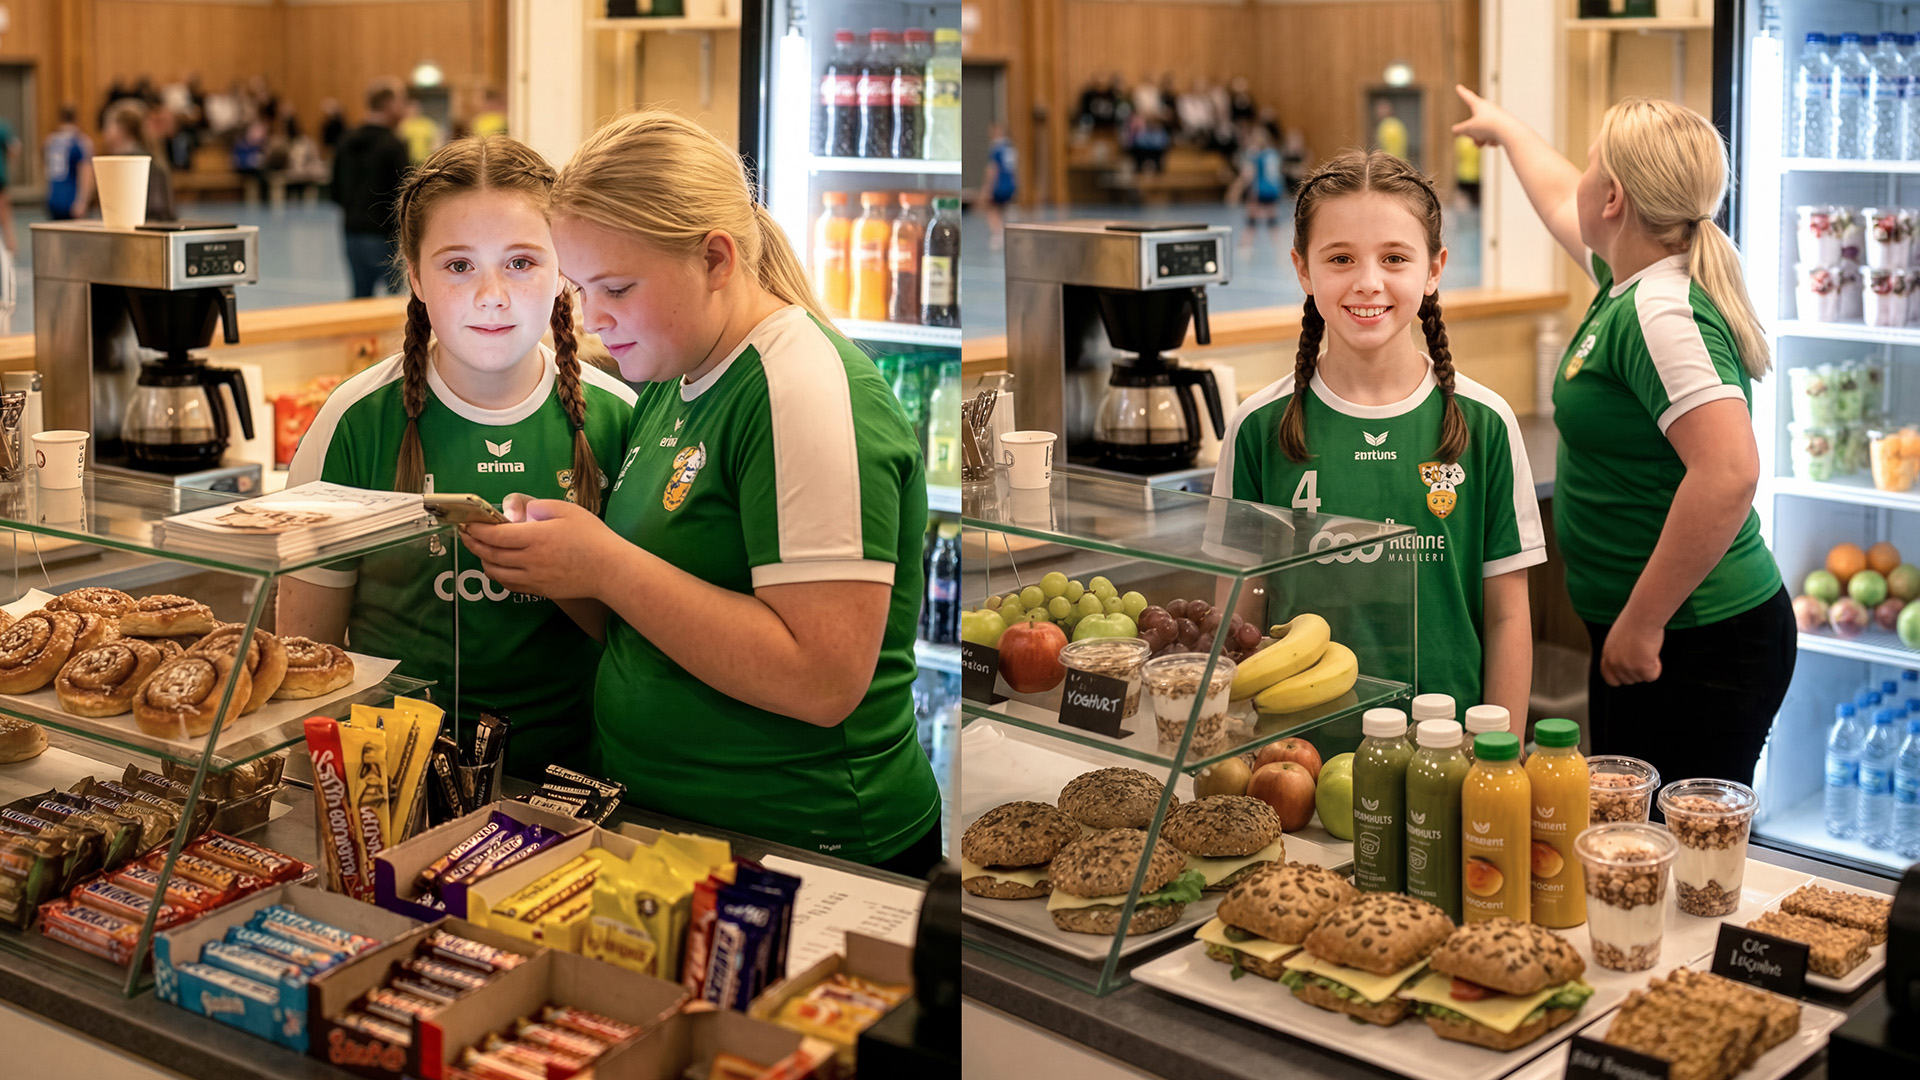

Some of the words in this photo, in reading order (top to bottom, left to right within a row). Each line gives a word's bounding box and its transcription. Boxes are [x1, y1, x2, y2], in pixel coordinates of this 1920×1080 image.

[477, 460, 525, 473] erima
[1292, 470, 1321, 519] 4
[1067, 690, 1121, 713] YOGHURT
